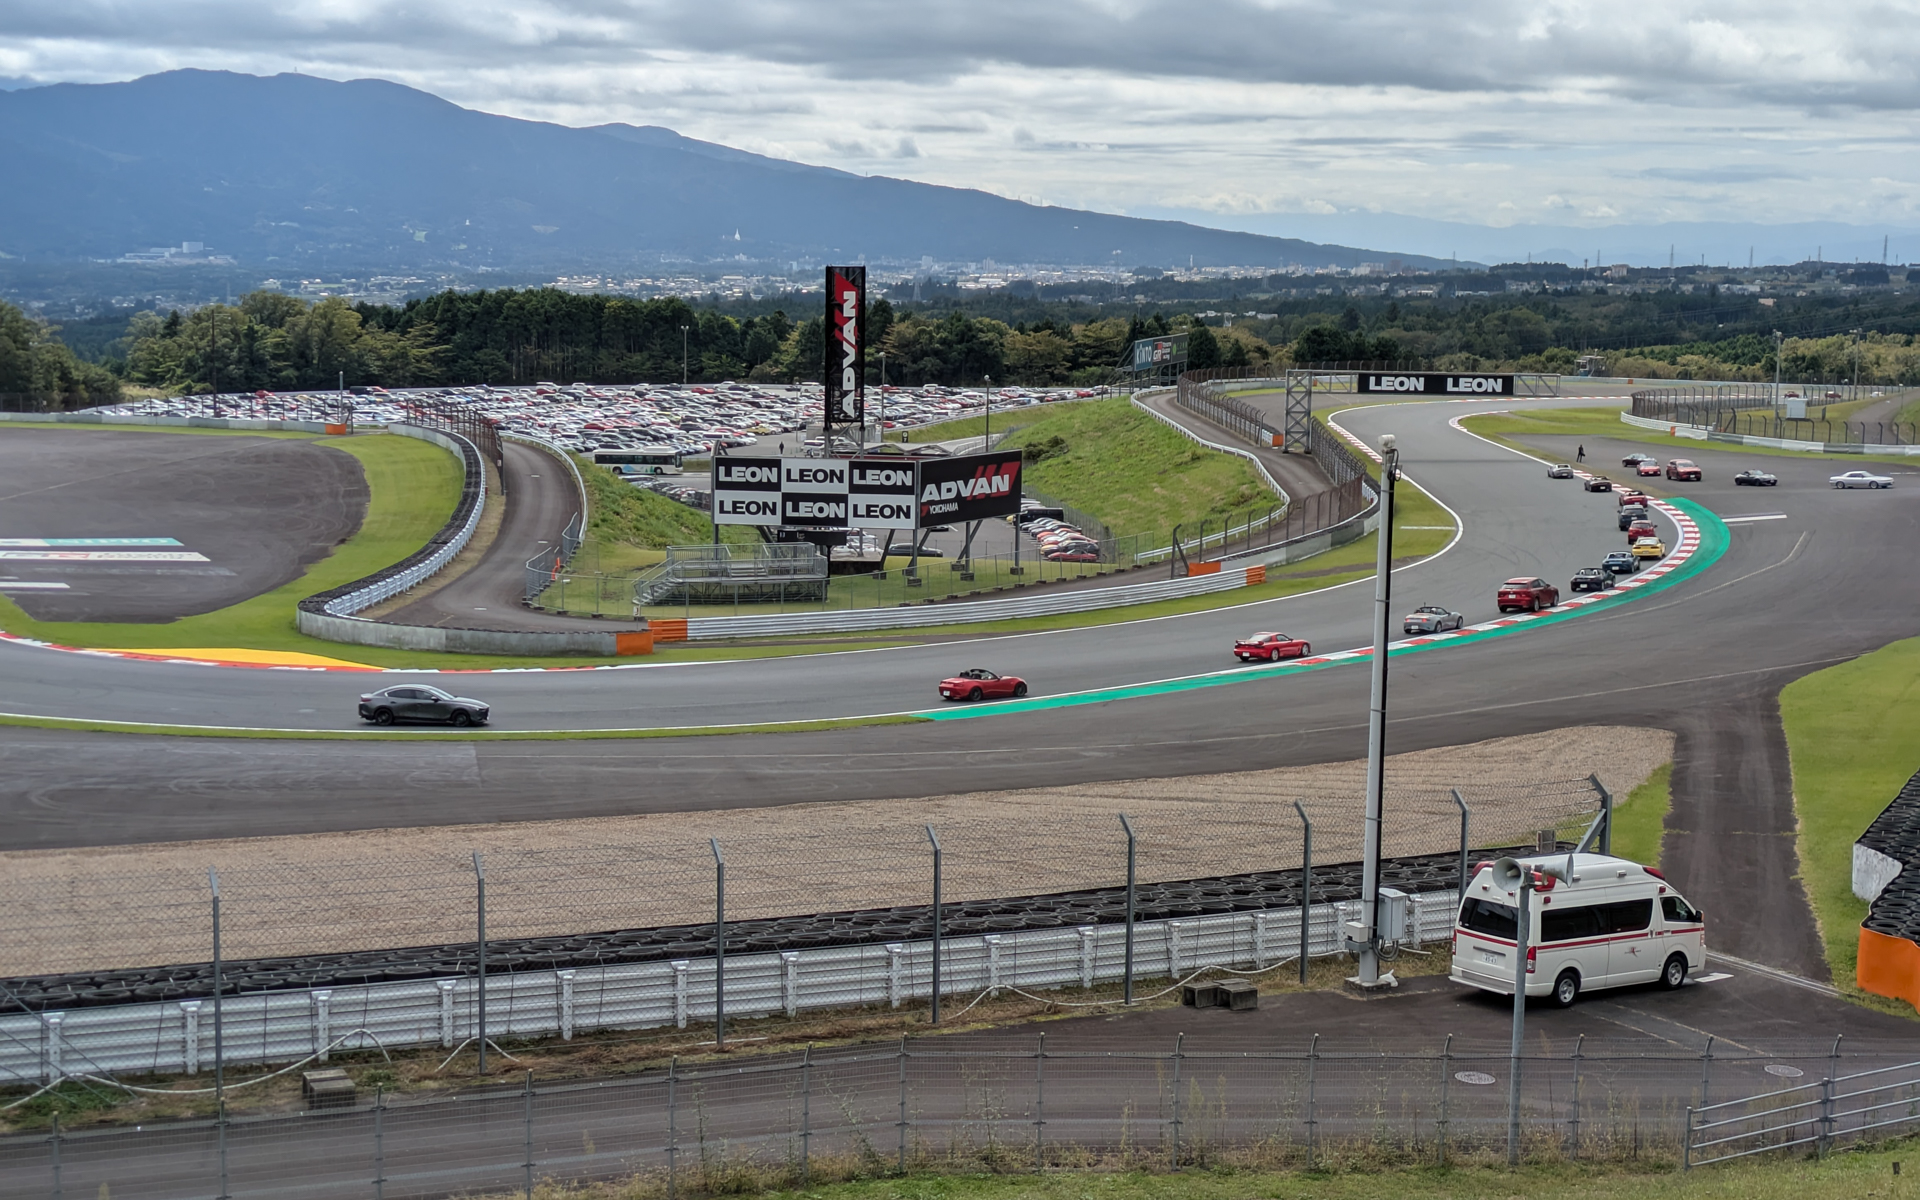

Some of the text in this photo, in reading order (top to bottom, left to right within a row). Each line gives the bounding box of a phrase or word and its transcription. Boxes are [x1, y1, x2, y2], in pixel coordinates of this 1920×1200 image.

[842, 291, 856, 418] ADVAN
[1369, 376, 1503, 393] LEON LEON
[718, 466, 913, 486] LEON LEON LEON
[920, 474, 1010, 503] ADVAN
[718, 500, 911, 519] LEON LEON LEON
[929, 502, 959, 514] YOKOHAMA
